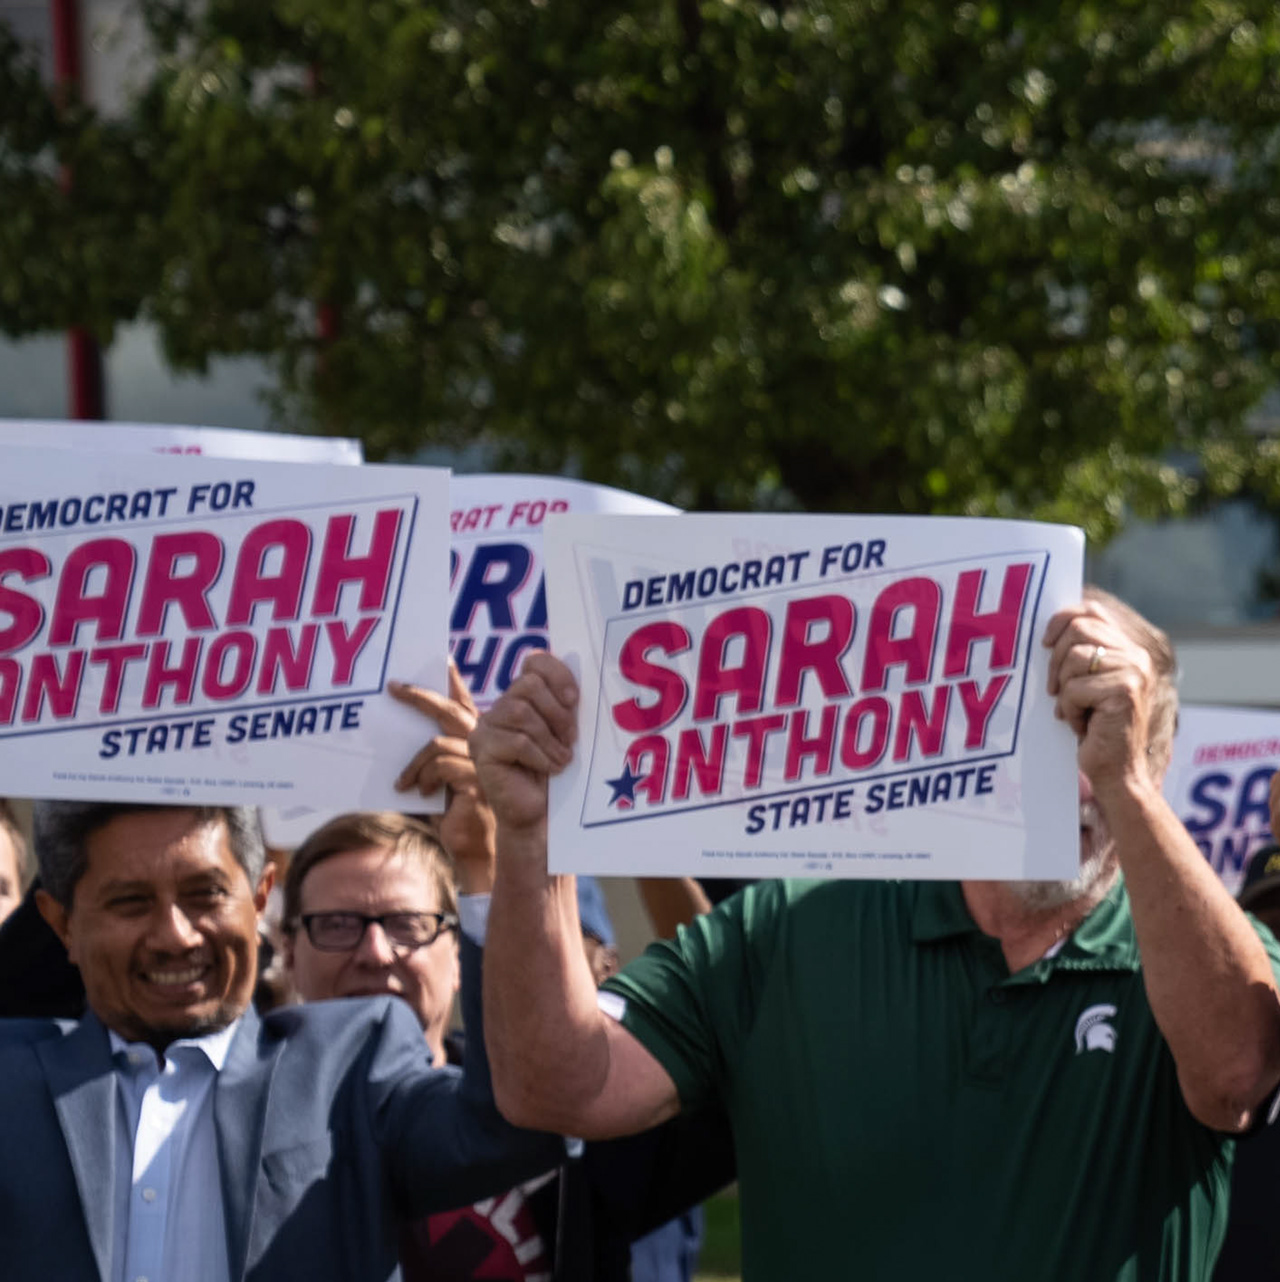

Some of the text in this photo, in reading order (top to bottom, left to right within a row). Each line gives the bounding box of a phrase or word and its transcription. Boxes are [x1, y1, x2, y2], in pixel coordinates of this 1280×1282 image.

[0, 480, 256, 533] EMOCRAT FOR
[0, 507, 404, 656] SARAH
[622, 539, 888, 611] DEMOCRAT FOR
[612, 564, 1035, 734] SARAH
[99, 701, 364, 758] STATE SENATE
[614, 675, 1012, 810] ANTHONY
[745, 764, 997, 835] STATE SENATE
